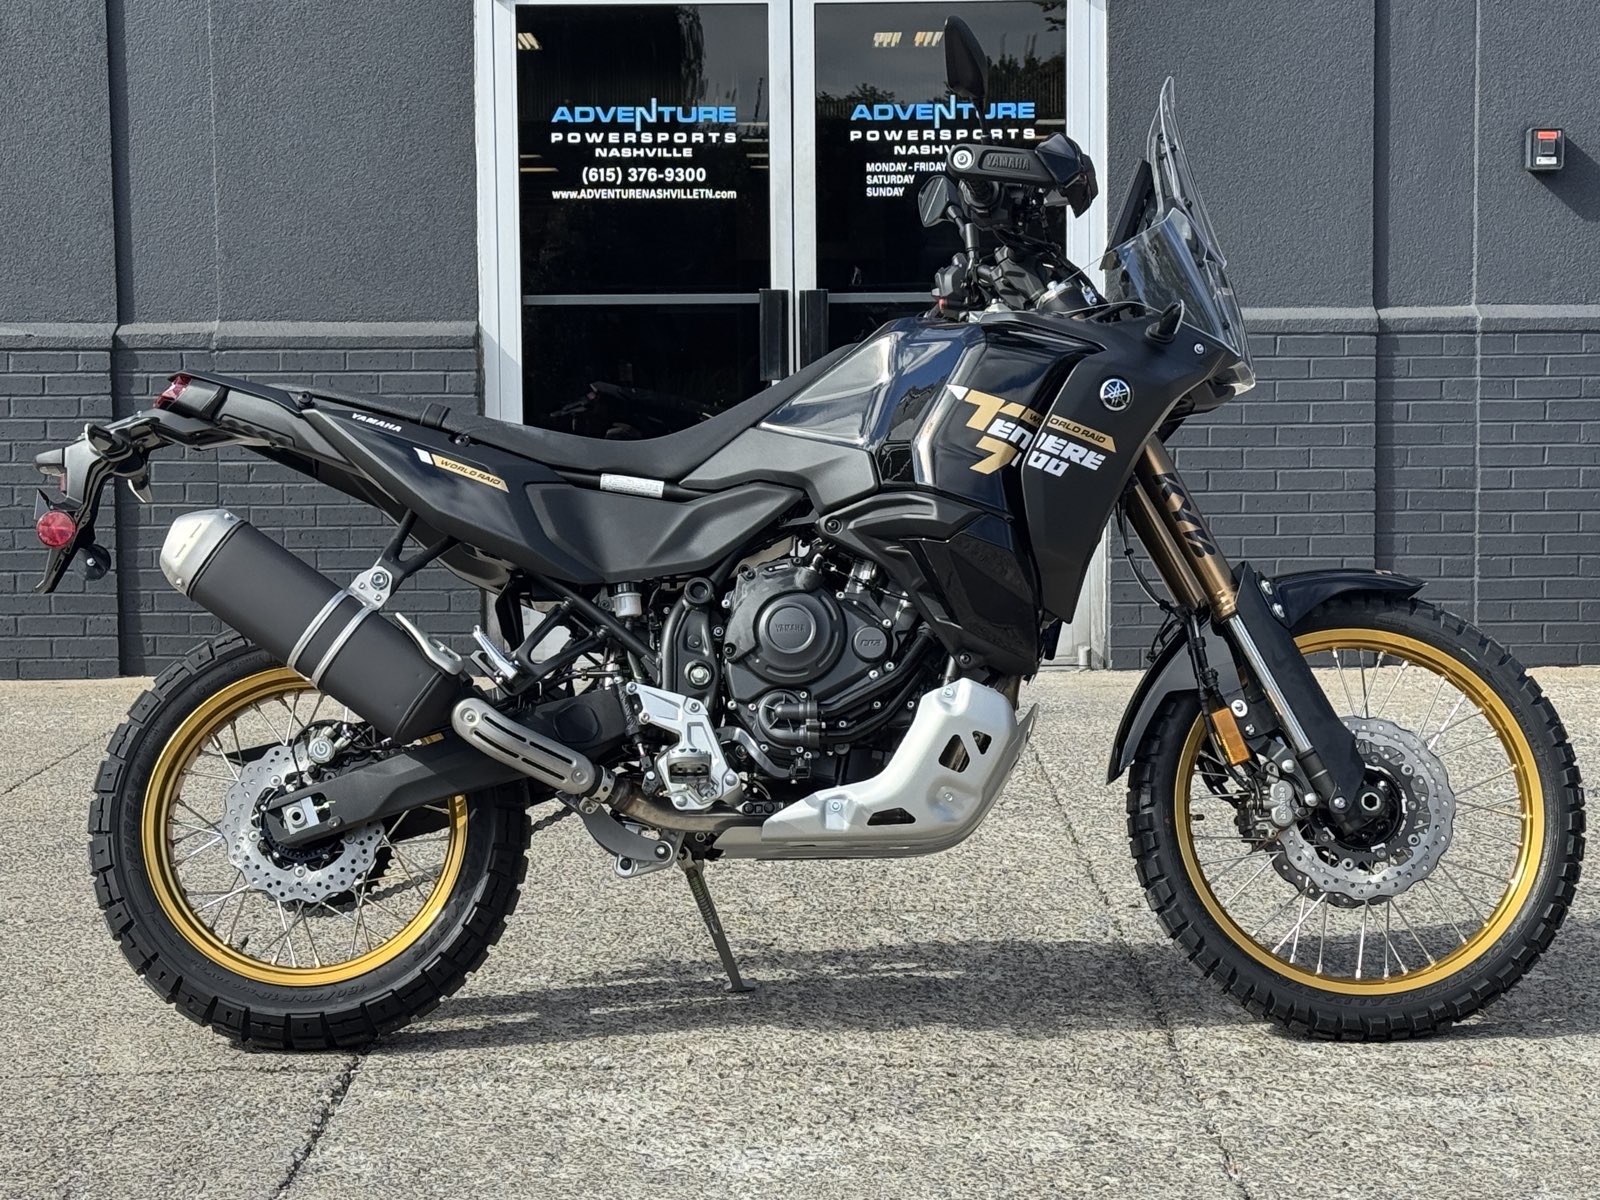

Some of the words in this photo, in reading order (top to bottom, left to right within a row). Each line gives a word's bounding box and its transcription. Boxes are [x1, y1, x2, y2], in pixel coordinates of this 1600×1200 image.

[551, 97, 736, 131] ADVENTURE
[551, 132, 737, 143] POWERSPORTS
[850, 128, 1036, 141] POWERSPORTS
[595, 147, 693, 157] NASHVILLE
[894, 144, 955, 155] NASHV
[988, 154, 1031, 171] YAMAHA
[582, 166, 623, 185] (615)
[627, 167, 706, 182] 376-9300
[866, 174, 915, 184] SATURDAY
[552, 188, 737, 199] www.ADVENTURENASHVILLETN.com
[866, 187, 905, 197] SUNDAY
[351, 412, 402, 433] YAMAHA
[1081, 427, 1106, 444] RAID
[440, 459, 477, 477] WORLD
[476, 473, 501, 486] RAID
[775, 623, 806, 633] YAMAHA
